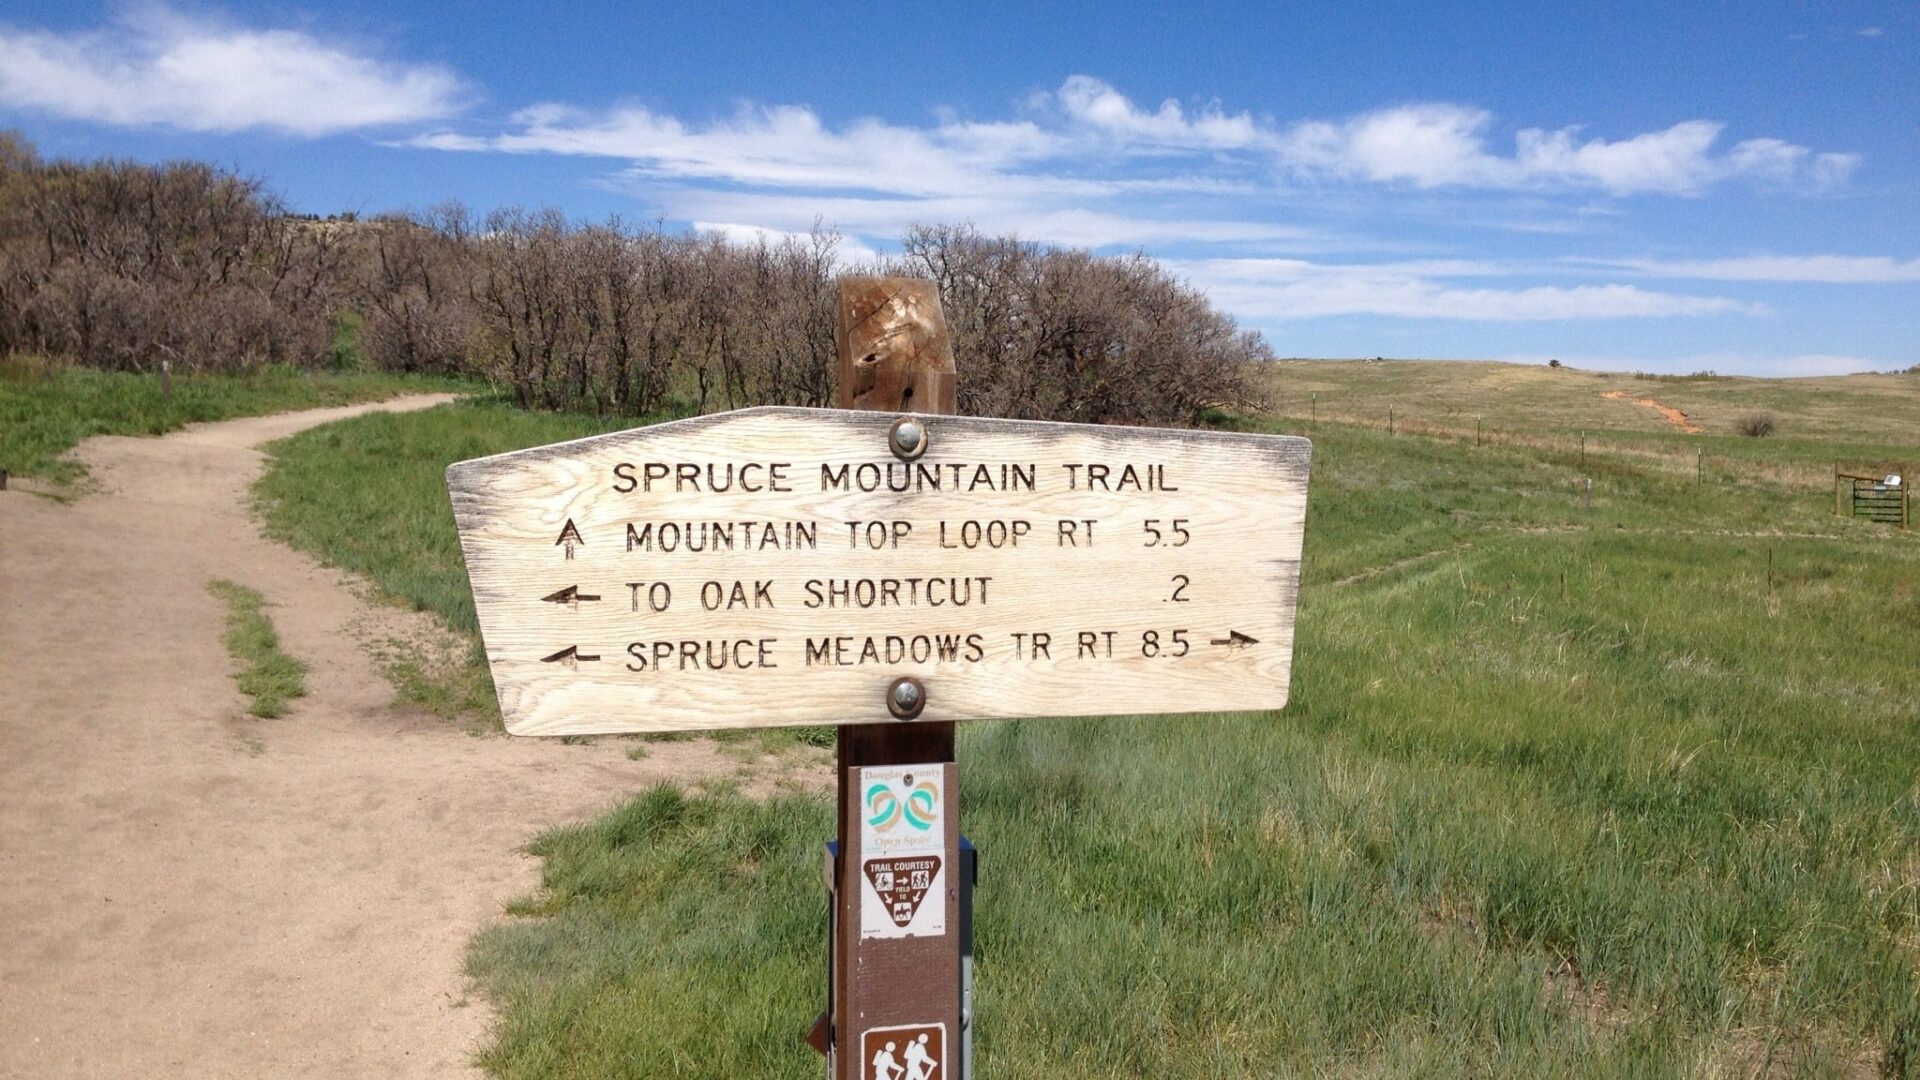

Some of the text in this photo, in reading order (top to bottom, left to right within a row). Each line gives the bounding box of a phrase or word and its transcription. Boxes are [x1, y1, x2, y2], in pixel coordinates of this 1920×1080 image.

[613, 462, 1178, 494] SPRUCE MOUNTAIN TRAIL
[625, 519, 1190, 553] MOUNTAIN TOP LOOP RT 5.5
[625, 574, 1190, 612] TO OAK SHORTCUT .2
[625, 629, 1190, 672] SPRUCE MEADOWS TR RT 8.5
[870, 860, 935, 872] TRAIL COURTESY
